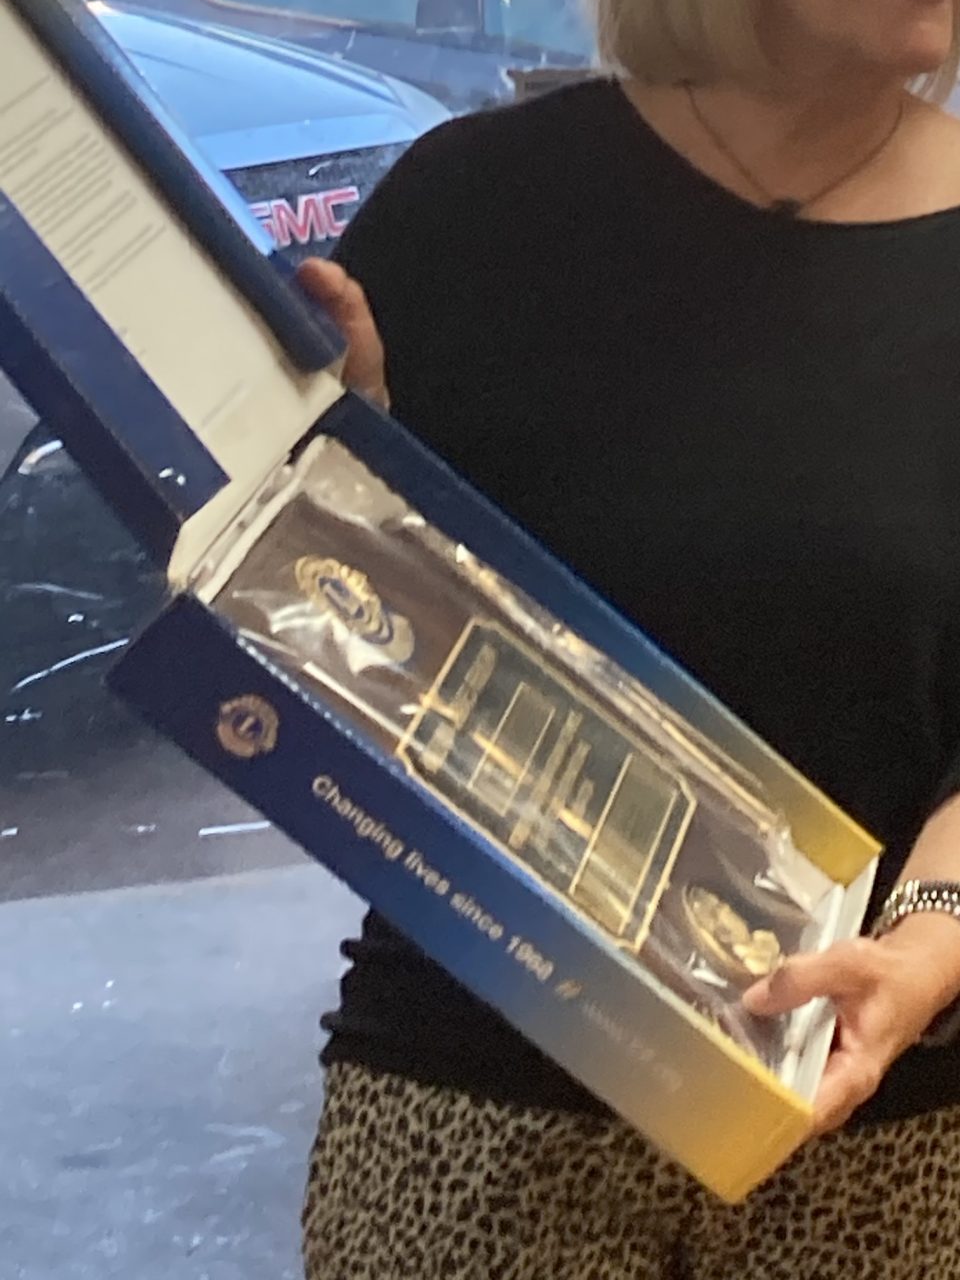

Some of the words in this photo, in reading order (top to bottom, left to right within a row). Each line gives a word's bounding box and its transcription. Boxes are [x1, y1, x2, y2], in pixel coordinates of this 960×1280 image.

[312, 775, 404, 860] Changing
[404, 849, 451, 896] lives
[451, 892, 504, 941] since
